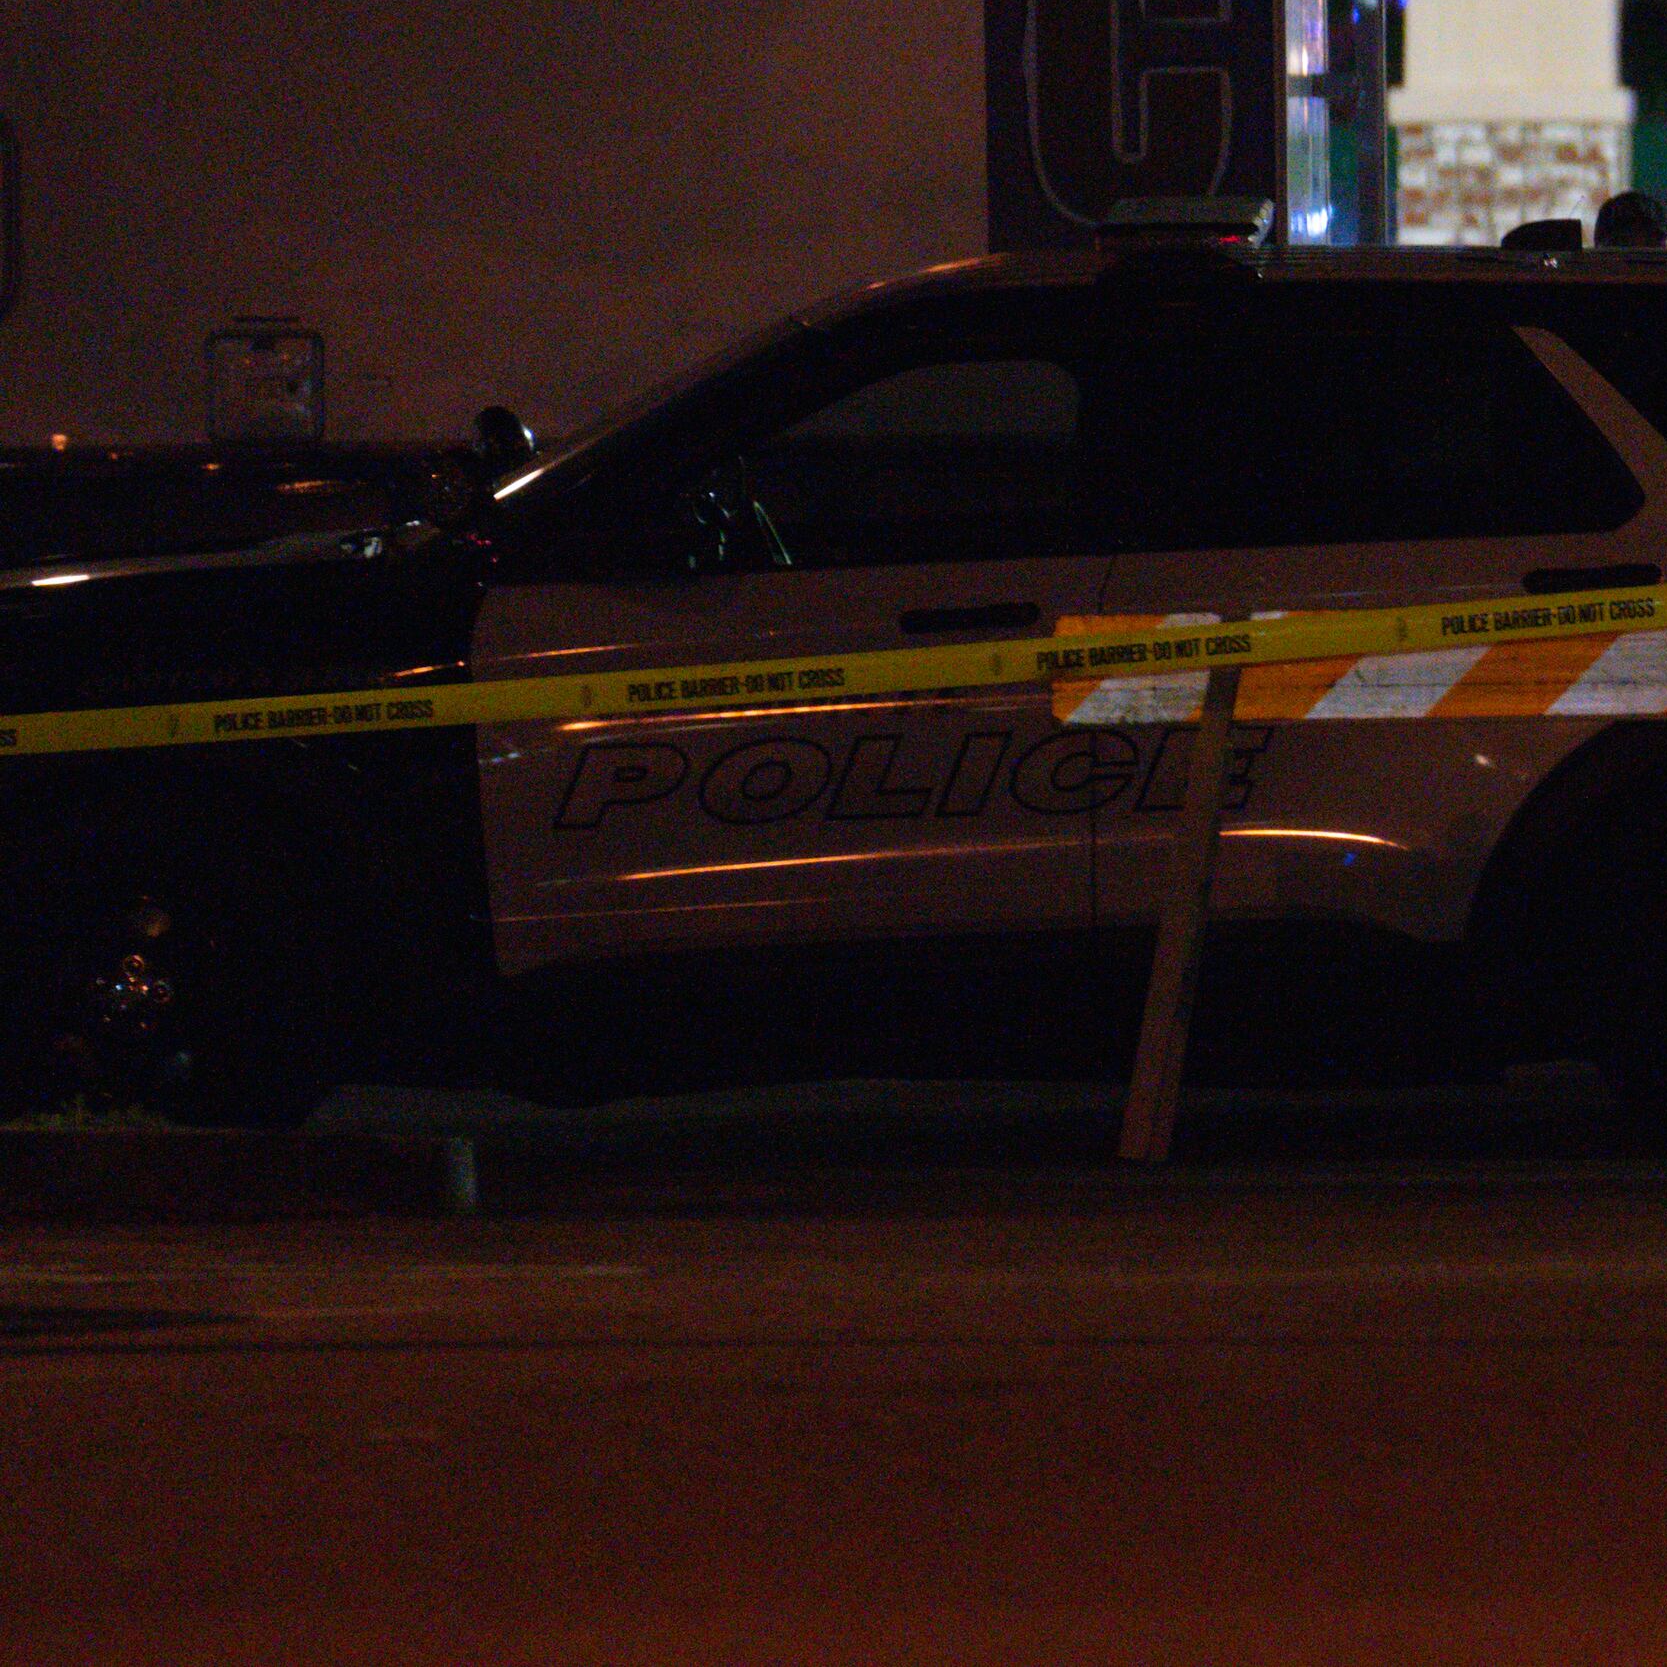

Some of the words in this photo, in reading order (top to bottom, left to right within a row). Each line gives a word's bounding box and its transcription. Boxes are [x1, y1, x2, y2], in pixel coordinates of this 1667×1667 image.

[1441, 613, 1489, 636] POLICE
[1578, 602, 1605, 624] NOT
[1609, 598, 1655, 620] CROSS
[1036, 648, 1083, 670] POLICE
[1174, 637, 1200, 658] NOT
[1205, 634, 1251, 655] CROSS
[628, 681, 673, 703] POLICE
[764, 671, 794, 692] NOT
[798, 667, 844, 688] CROSS
[213, 713, 261, 733] POLICE
[353, 703, 382, 723] NOT
[386, 699, 433, 721] CROSS
[554, 725, 1275, 830] POLICE
